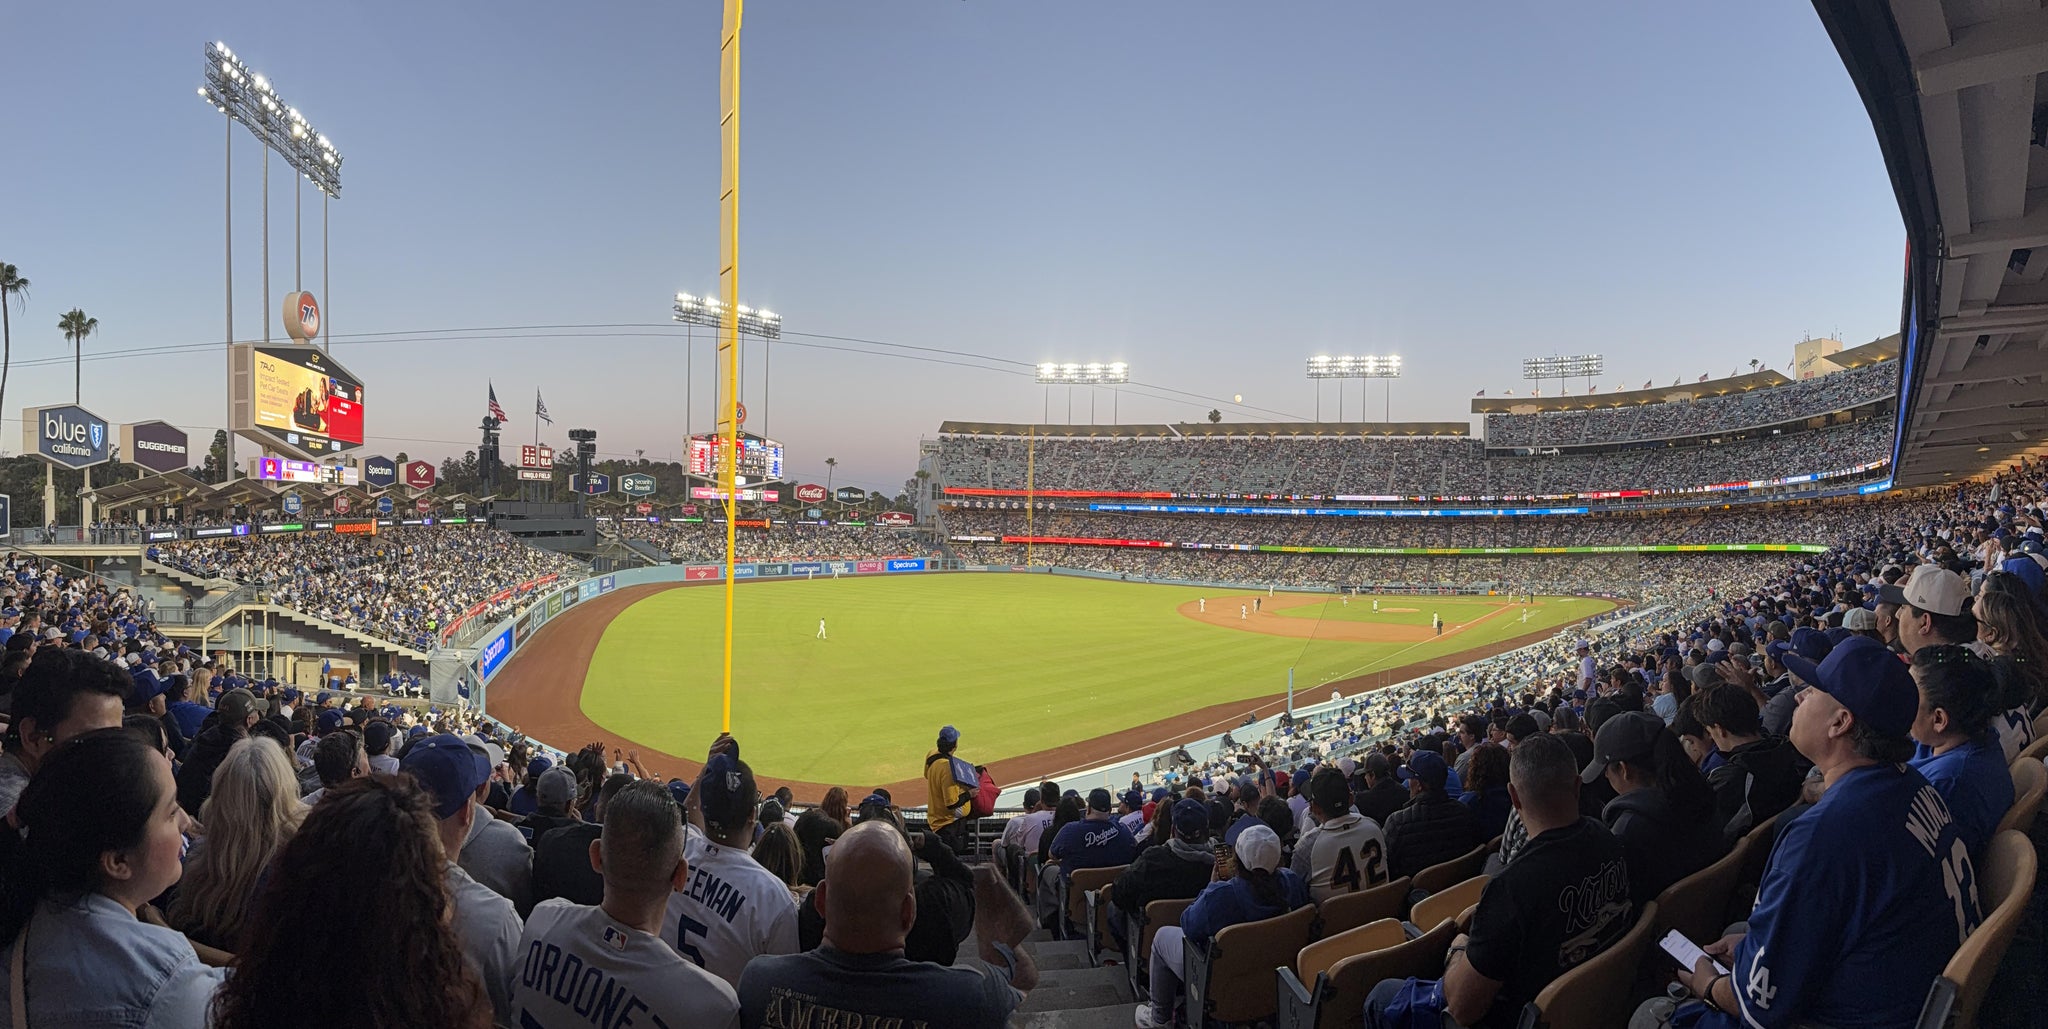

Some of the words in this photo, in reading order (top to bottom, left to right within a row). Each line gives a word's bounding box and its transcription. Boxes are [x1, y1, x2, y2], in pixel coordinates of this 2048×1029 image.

[302, 304, 316, 328] 76
[45, 412, 86, 443] blue
[52, 443, 91, 457] california
[138, 440, 186, 454] GUGGENHEIM
[540, 449, 551, 457] UNI
[368, 465, 392, 476] Spectrum
[540, 457, 551, 465] QLO
[893, 561, 916, 569] Spectrum
[484, 637, 505, 669] Spectrum
[1085, 826, 1119, 847] Dodgers
[1330, 837, 1390, 893] 42
[682, 864, 746, 924] EEMAN
[678, 913, 708, 970] 5
[522, 939, 668, 1029] ORDONE
[1746, 945, 1777, 1010] LA
